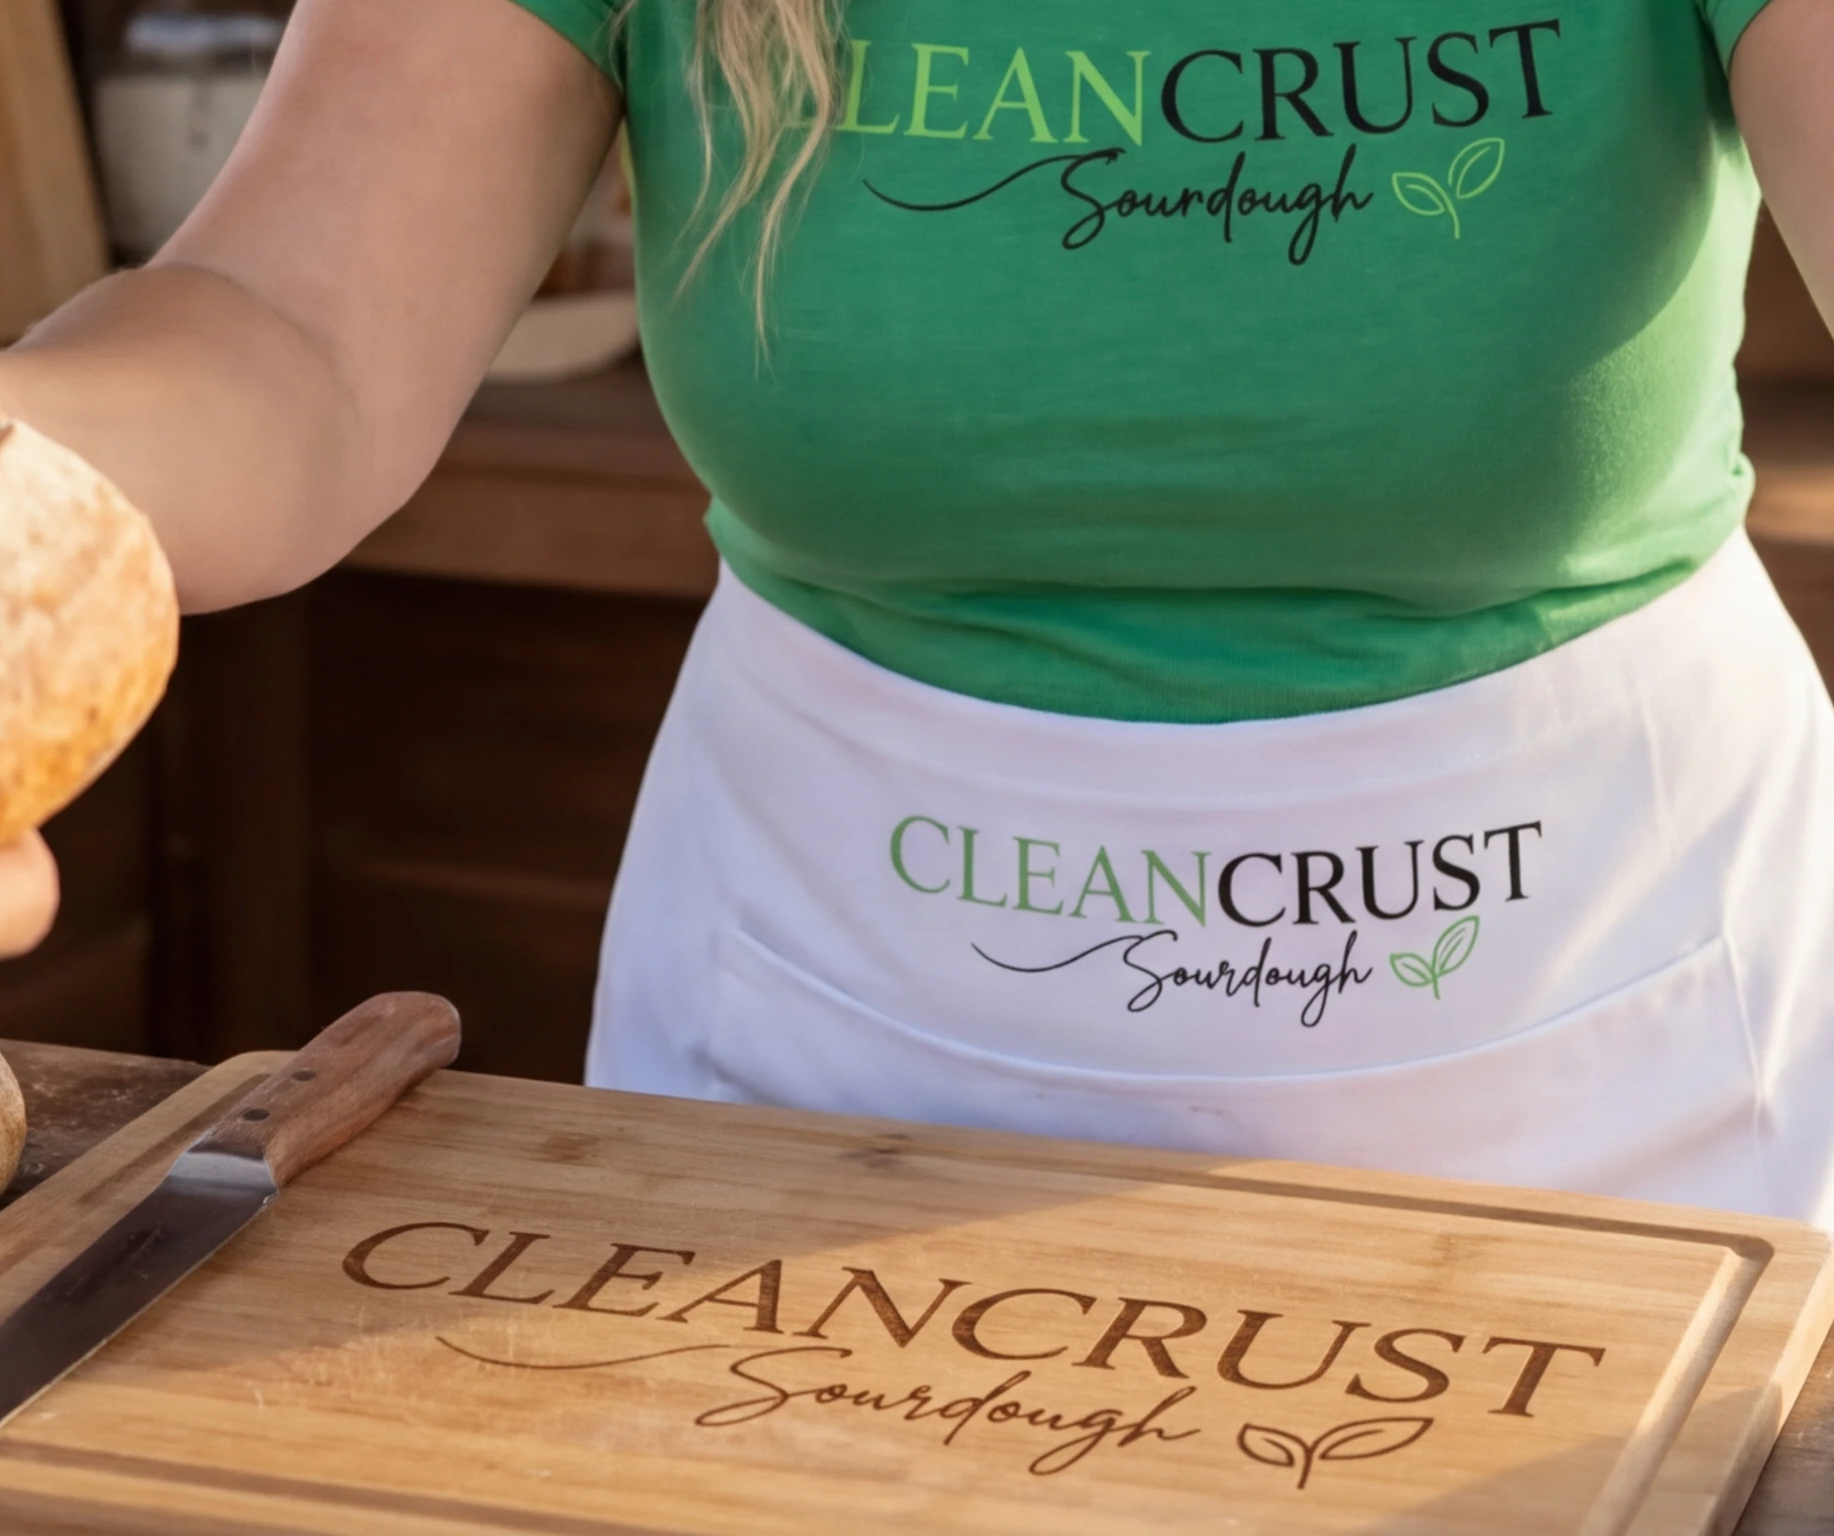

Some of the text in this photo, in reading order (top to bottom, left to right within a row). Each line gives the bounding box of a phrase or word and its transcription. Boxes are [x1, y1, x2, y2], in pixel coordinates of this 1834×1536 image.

[783, 19, 1561, 147] LEANCRUST
[1060, 144, 1373, 265] Sourdough
[890, 814, 1542, 927] CLEANCRUST
[1122, 929, 1373, 1028] Sourdough
[341, 1221, 1606, 1419] CLEANCRUST
[694, 1346, 1201, 1477] Sourdough
